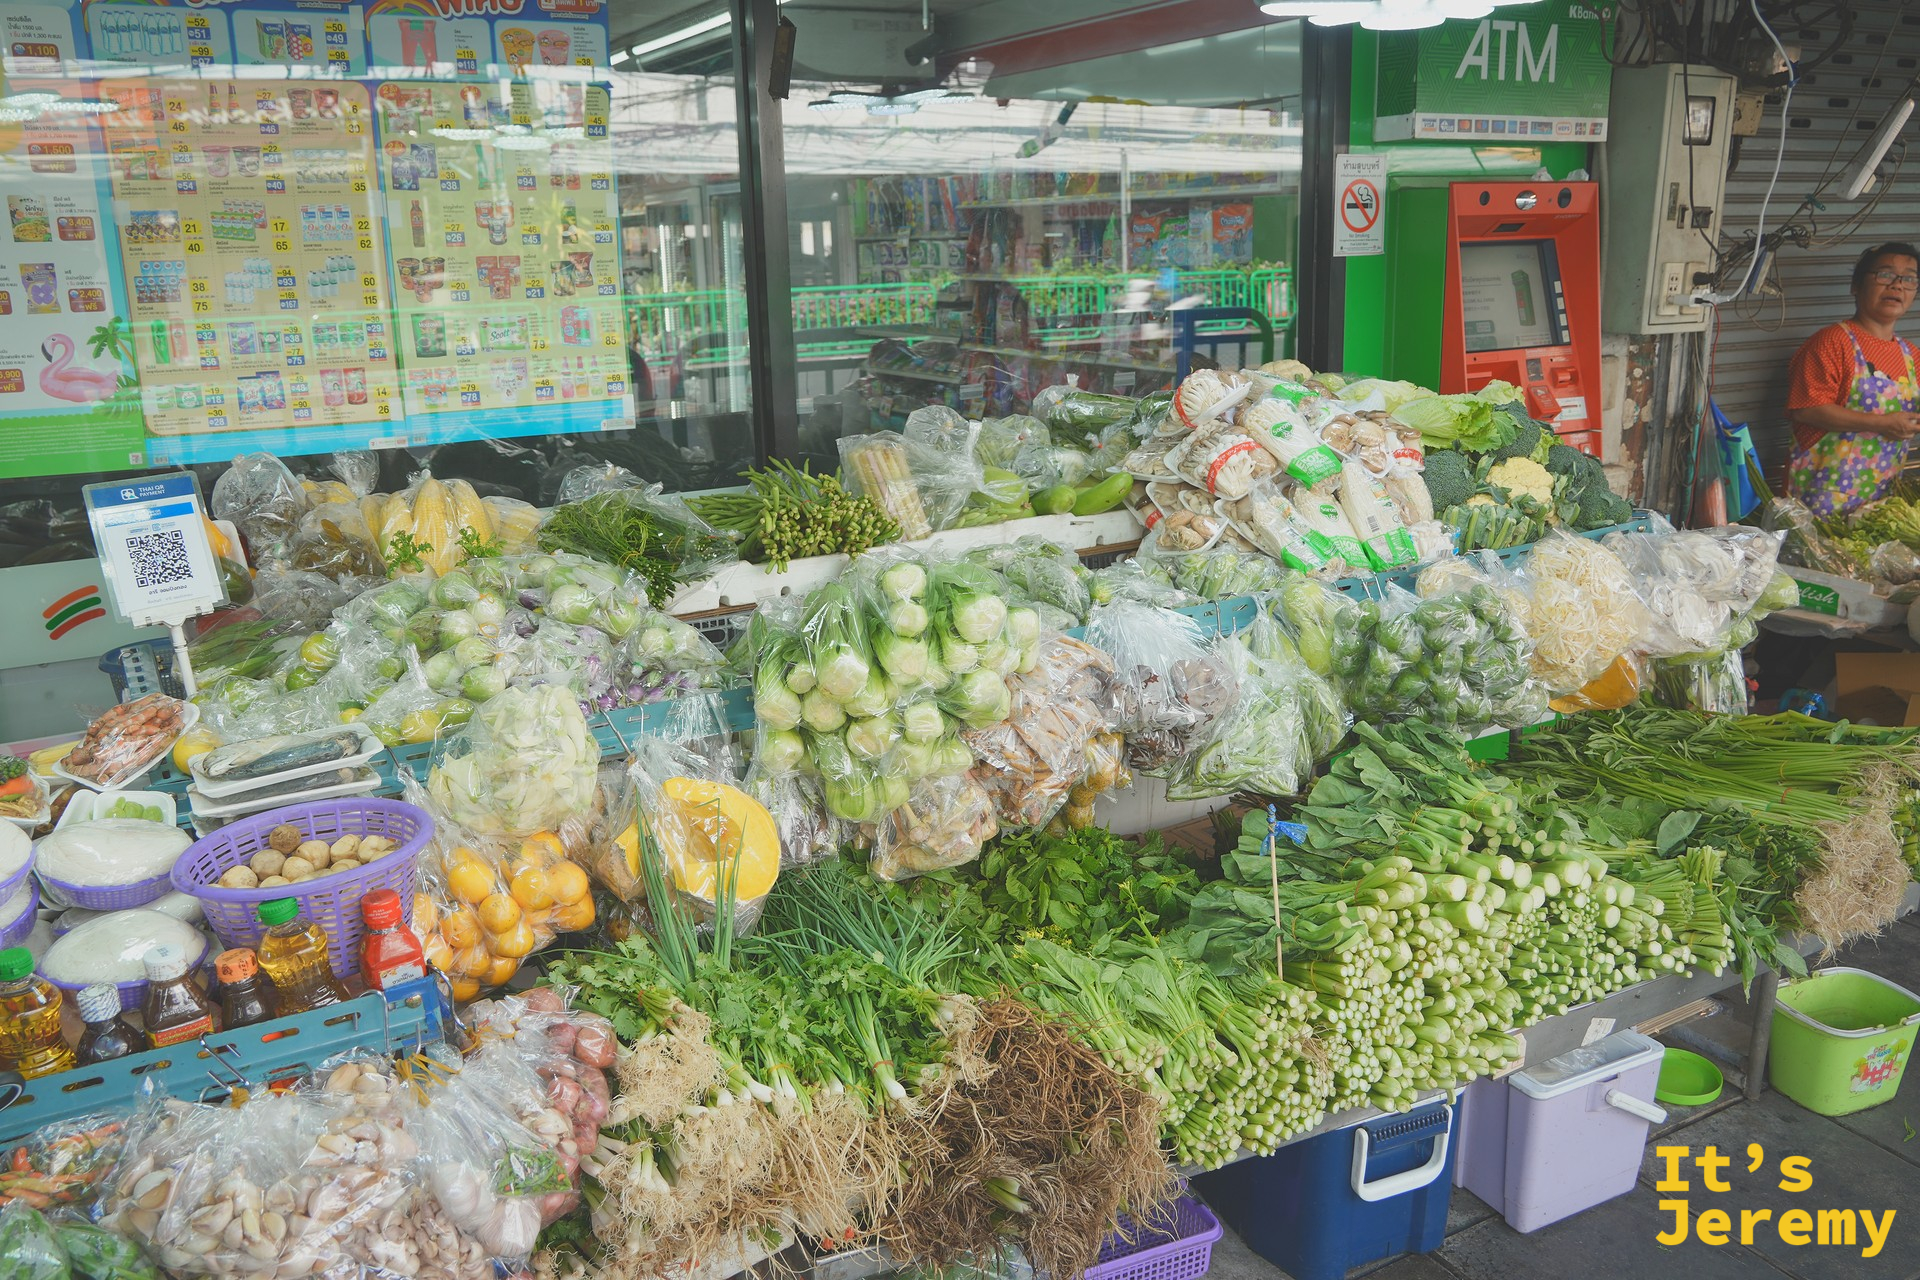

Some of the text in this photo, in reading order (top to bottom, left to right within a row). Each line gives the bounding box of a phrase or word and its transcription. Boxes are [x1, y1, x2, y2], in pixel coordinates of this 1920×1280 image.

[27, 46, 56, 56] 1,100
[1455, 19, 1558, 83] ATM
[463, 61, 475, 70] 118
[169, 102, 182, 111] 24
[593, 116, 602, 125] 45
[172, 122, 185, 131] 46
[593, 127, 603, 135] 44
[43, 145, 71, 155] 1,500
[446, 172, 455, 180] 39
[446, 182, 457, 190] 38
[523, 177, 533, 186] 94
[596, 180, 606, 189] 54
[354, 182, 366, 191] 35
[69, 218, 91, 226] 3,400
[274, 222, 285, 231] 17
[358, 220, 369, 230] 22
[185, 224, 197, 233] 21
[74, 231, 87, 239] ฟรี
[451, 233, 462, 241] 26
[528, 235, 538, 243] 45
[600, 234, 610, 242] 29
[188, 243, 200, 253] 40
[276, 241, 288, 251] 65
[360, 239, 372, 249] 62
[193, 282, 205, 291] 38
[283, 278, 293, 286] 93
[364, 278, 375, 287] 60
[80, 289, 101, 297] 2,400
[456, 292, 467, 300] 19
[531, 289, 540, 297] 21
[364, 296, 377, 305] 115
[85, 302, 97, 310] ฟรี
[195, 302, 208, 311] 75
[490, 329, 510, 341] Scott
[534, 340, 546, 349] 79
[605, 336, 617, 345] 85
[611, 374, 621, 382] 69
[612, 383, 622, 391] 68
[376, 388, 387, 396] 14
[541, 388, 551, 396] 47
[467, 393, 478, 401] 78
[378, 406, 390, 415] 26
[140, 489, 165, 497] PAYMENT
